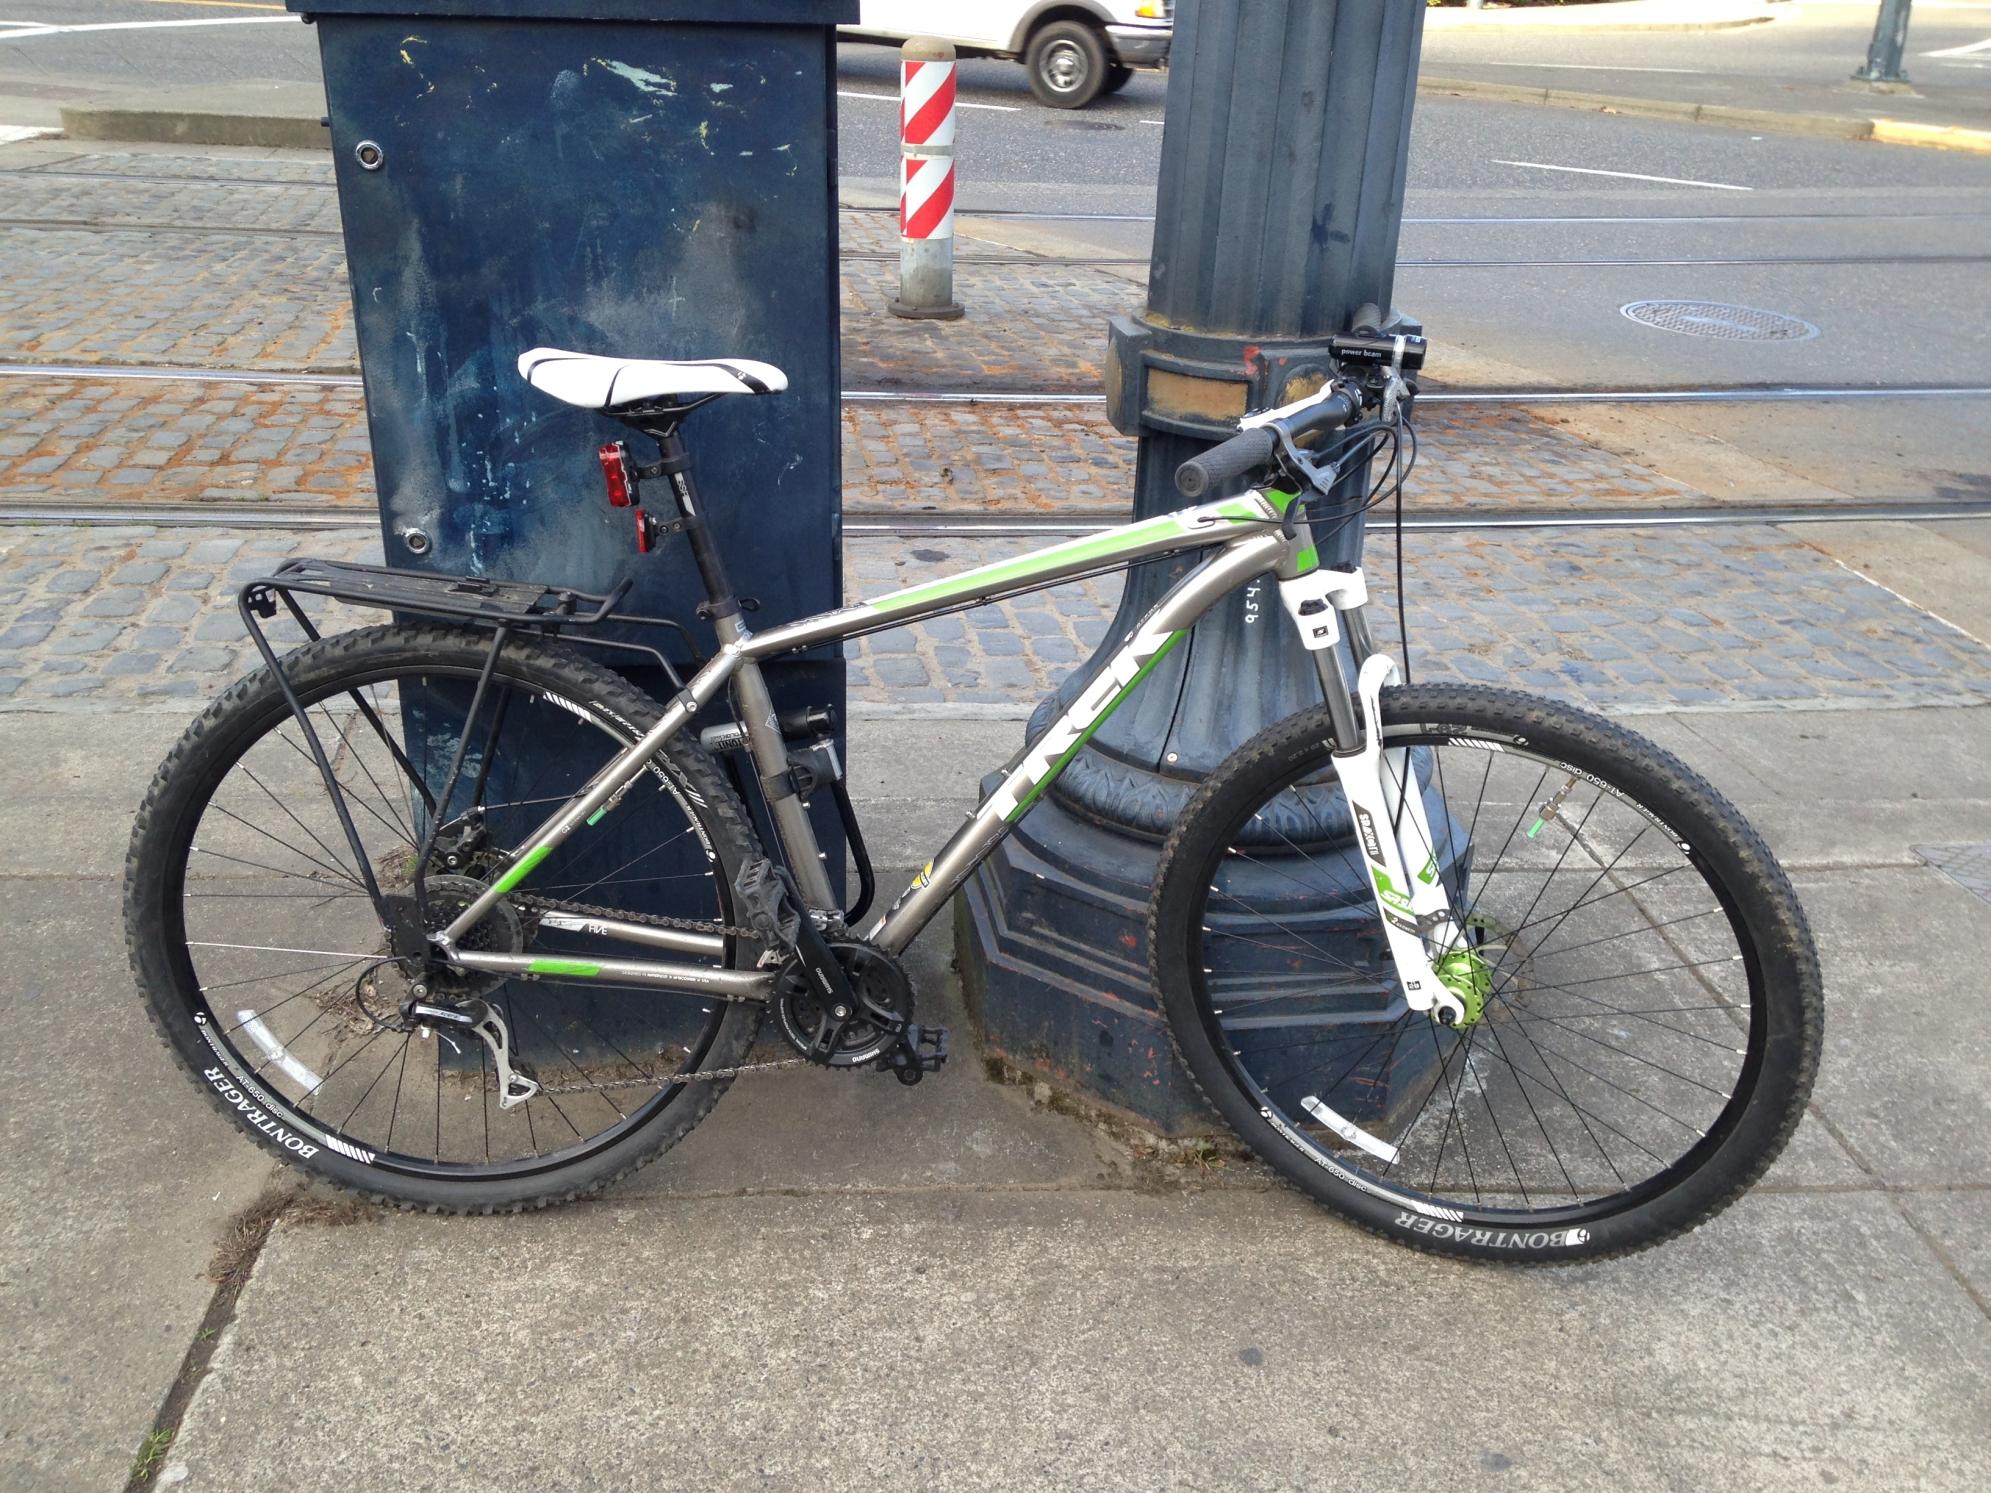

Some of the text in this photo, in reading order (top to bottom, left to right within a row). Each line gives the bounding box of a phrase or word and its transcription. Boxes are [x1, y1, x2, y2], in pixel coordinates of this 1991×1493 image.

[976, 612, 1176, 823] TREK
[203, 1066, 319, 1160] BONTRAGER
[235, 1074, 265, 1103] AT-650
[264, 1101, 284, 1118] disc
[1313, 1156, 1346, 1182] AT-650
[1344, 1176, 1368, 1193] disc
[1394, 1212, 1569, 1250] BONTRAGER
